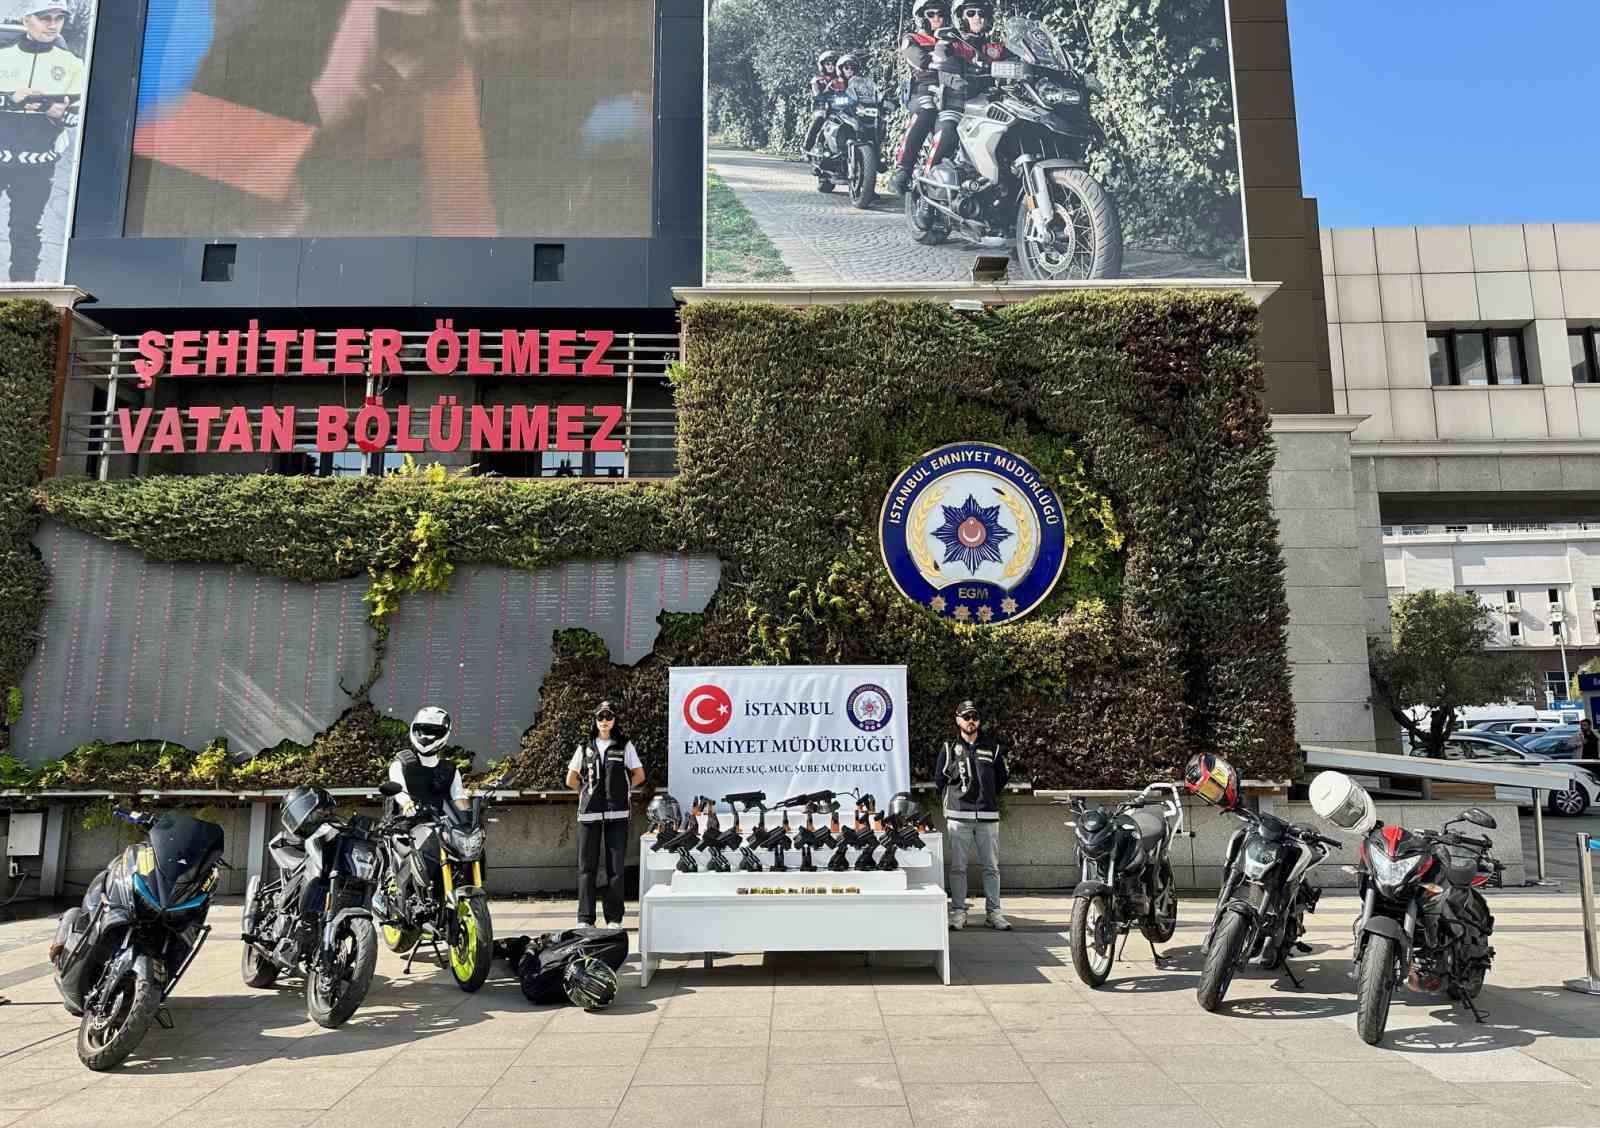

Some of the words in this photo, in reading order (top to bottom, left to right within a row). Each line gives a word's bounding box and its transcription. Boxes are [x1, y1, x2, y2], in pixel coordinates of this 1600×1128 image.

[132, 319, 403, 389] ŞEHİTLER
[425, 319, 614, 376] ÖLMEZ
[118, 405, 295, 454] VATAN
[316, 395, 624, 453] BÖLÜNMEZ
[958, 587, 989, 599] EGM
[744, 699, 834, 716] İSTANBUL
[684, 736, 768, 755] EMNİYET
[772, 735, 894, 753] MÜDÜRLÜĞÜ
